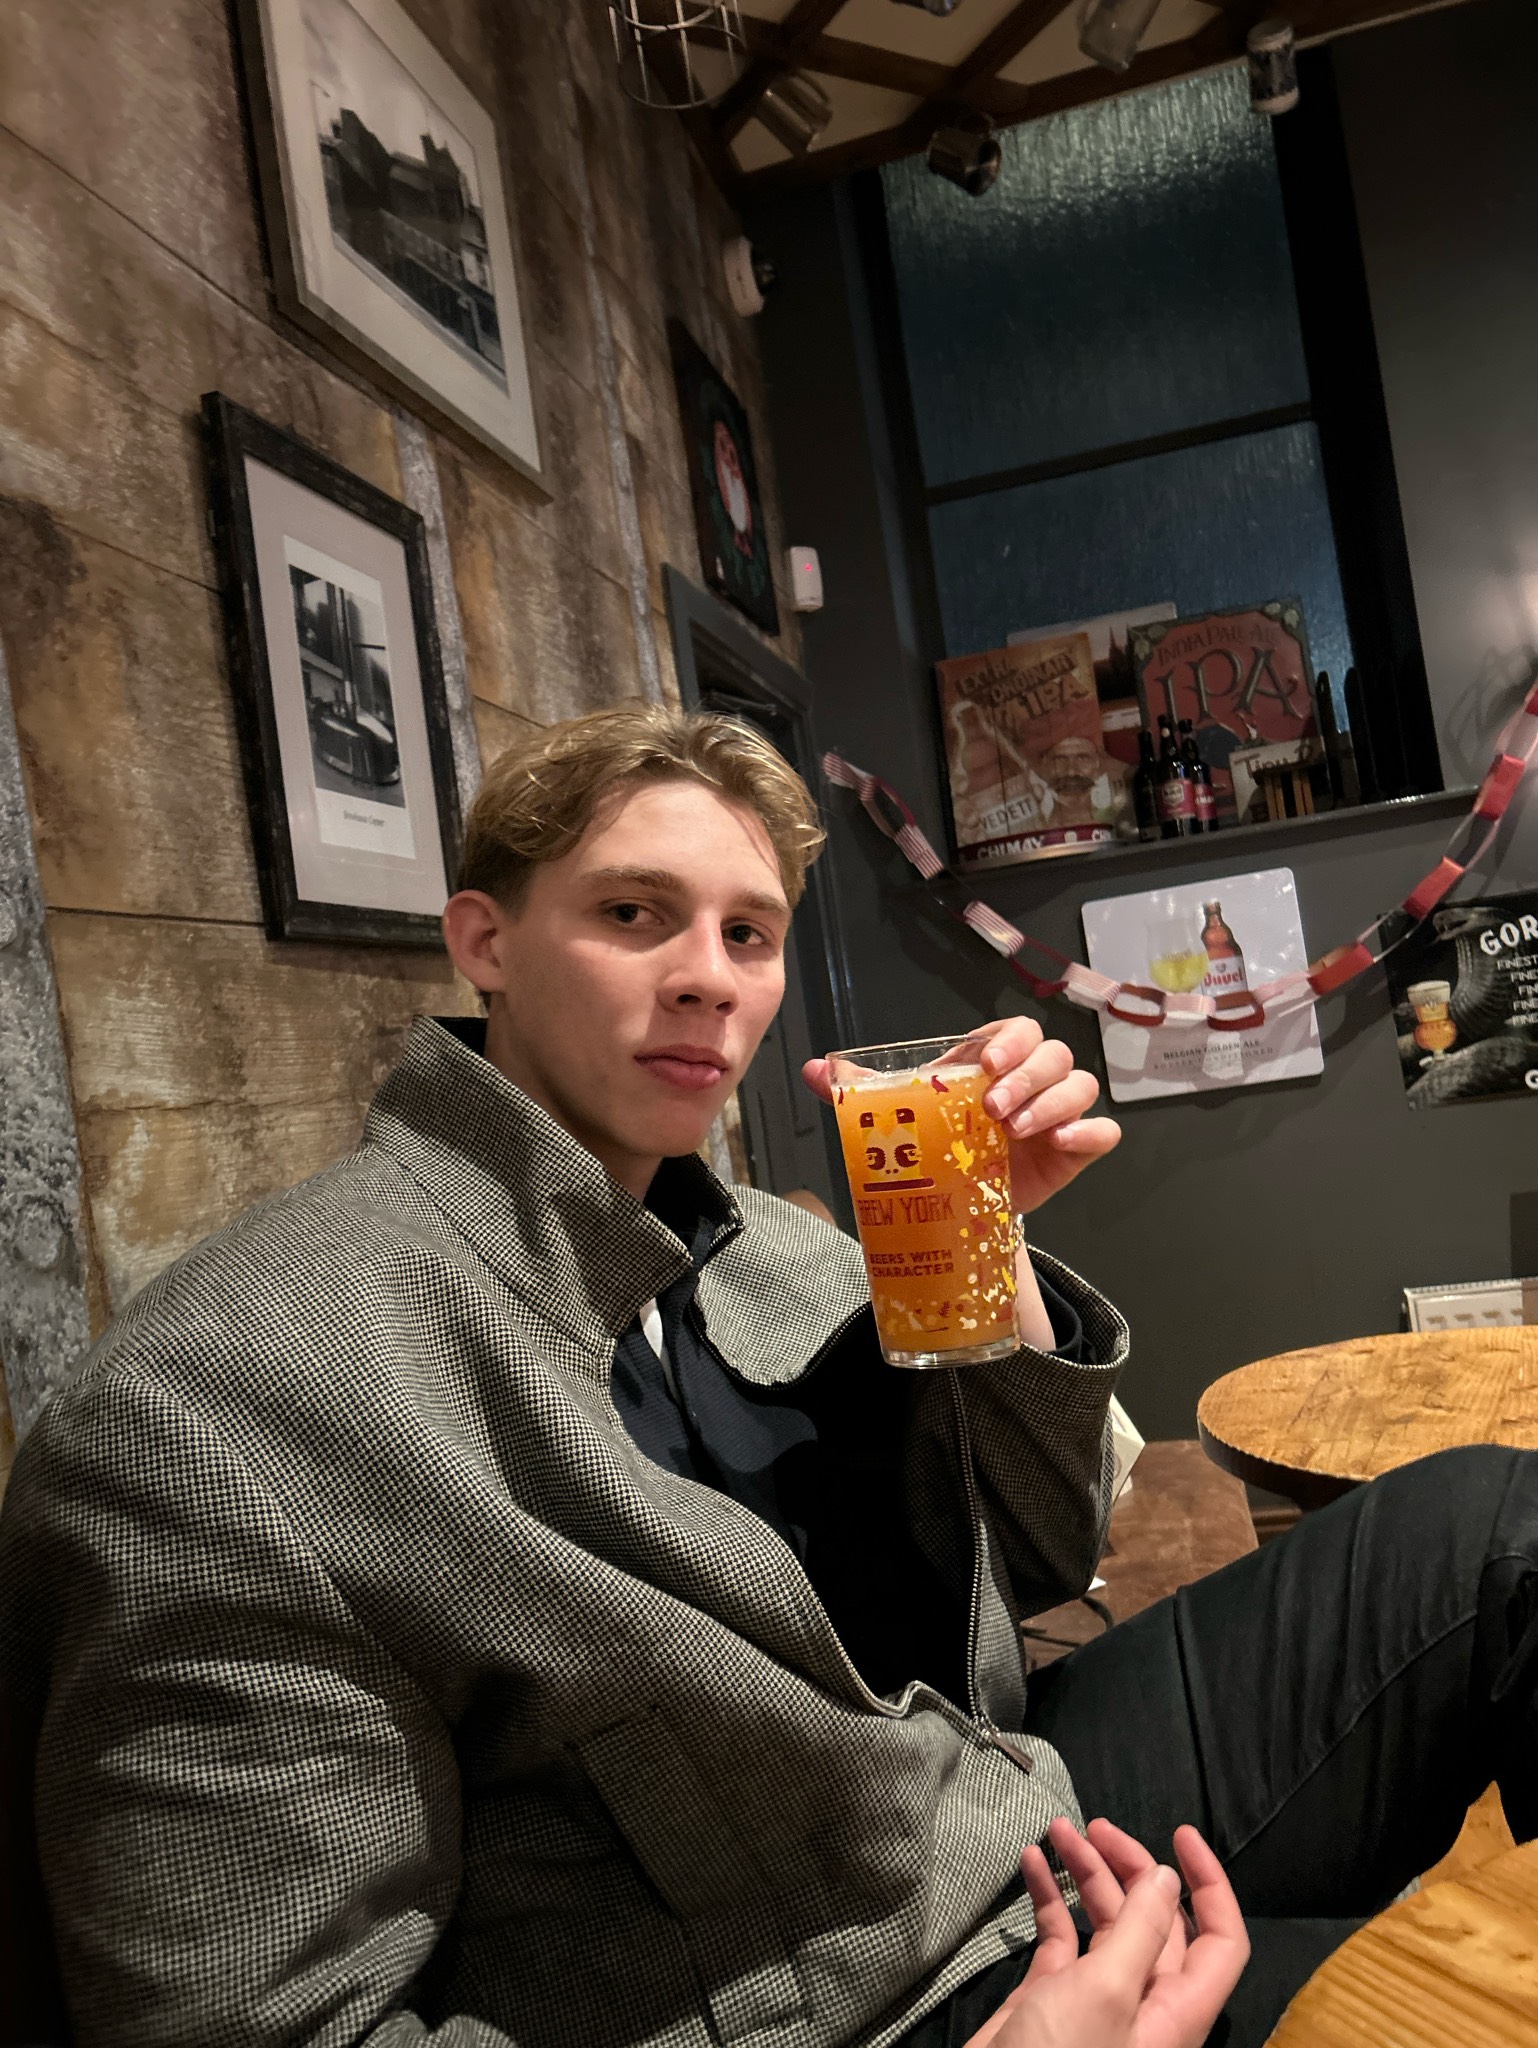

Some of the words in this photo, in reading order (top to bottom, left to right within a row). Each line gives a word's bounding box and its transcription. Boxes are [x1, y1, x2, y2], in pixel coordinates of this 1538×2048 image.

[1022, 674, 1090, 719] IPA
[1154, 647, 1303, 726] IPA
[977, 834, 1046, 860] CHIMAY
[1479, 914, 1538, 956] GOR
[1204, 968, 1243, 987] Duvel
[1510, 969, 1538, 983] FINE
[1163, 1049, 1201, 1060] BELGIAN
[1243, 1040, 1260, 1049] ALE
[899, 1192, 956, 1225] YORK
[909, 1248, 953, 1263] WITH
[872, 1261, 955, 1278] CHARACTER
